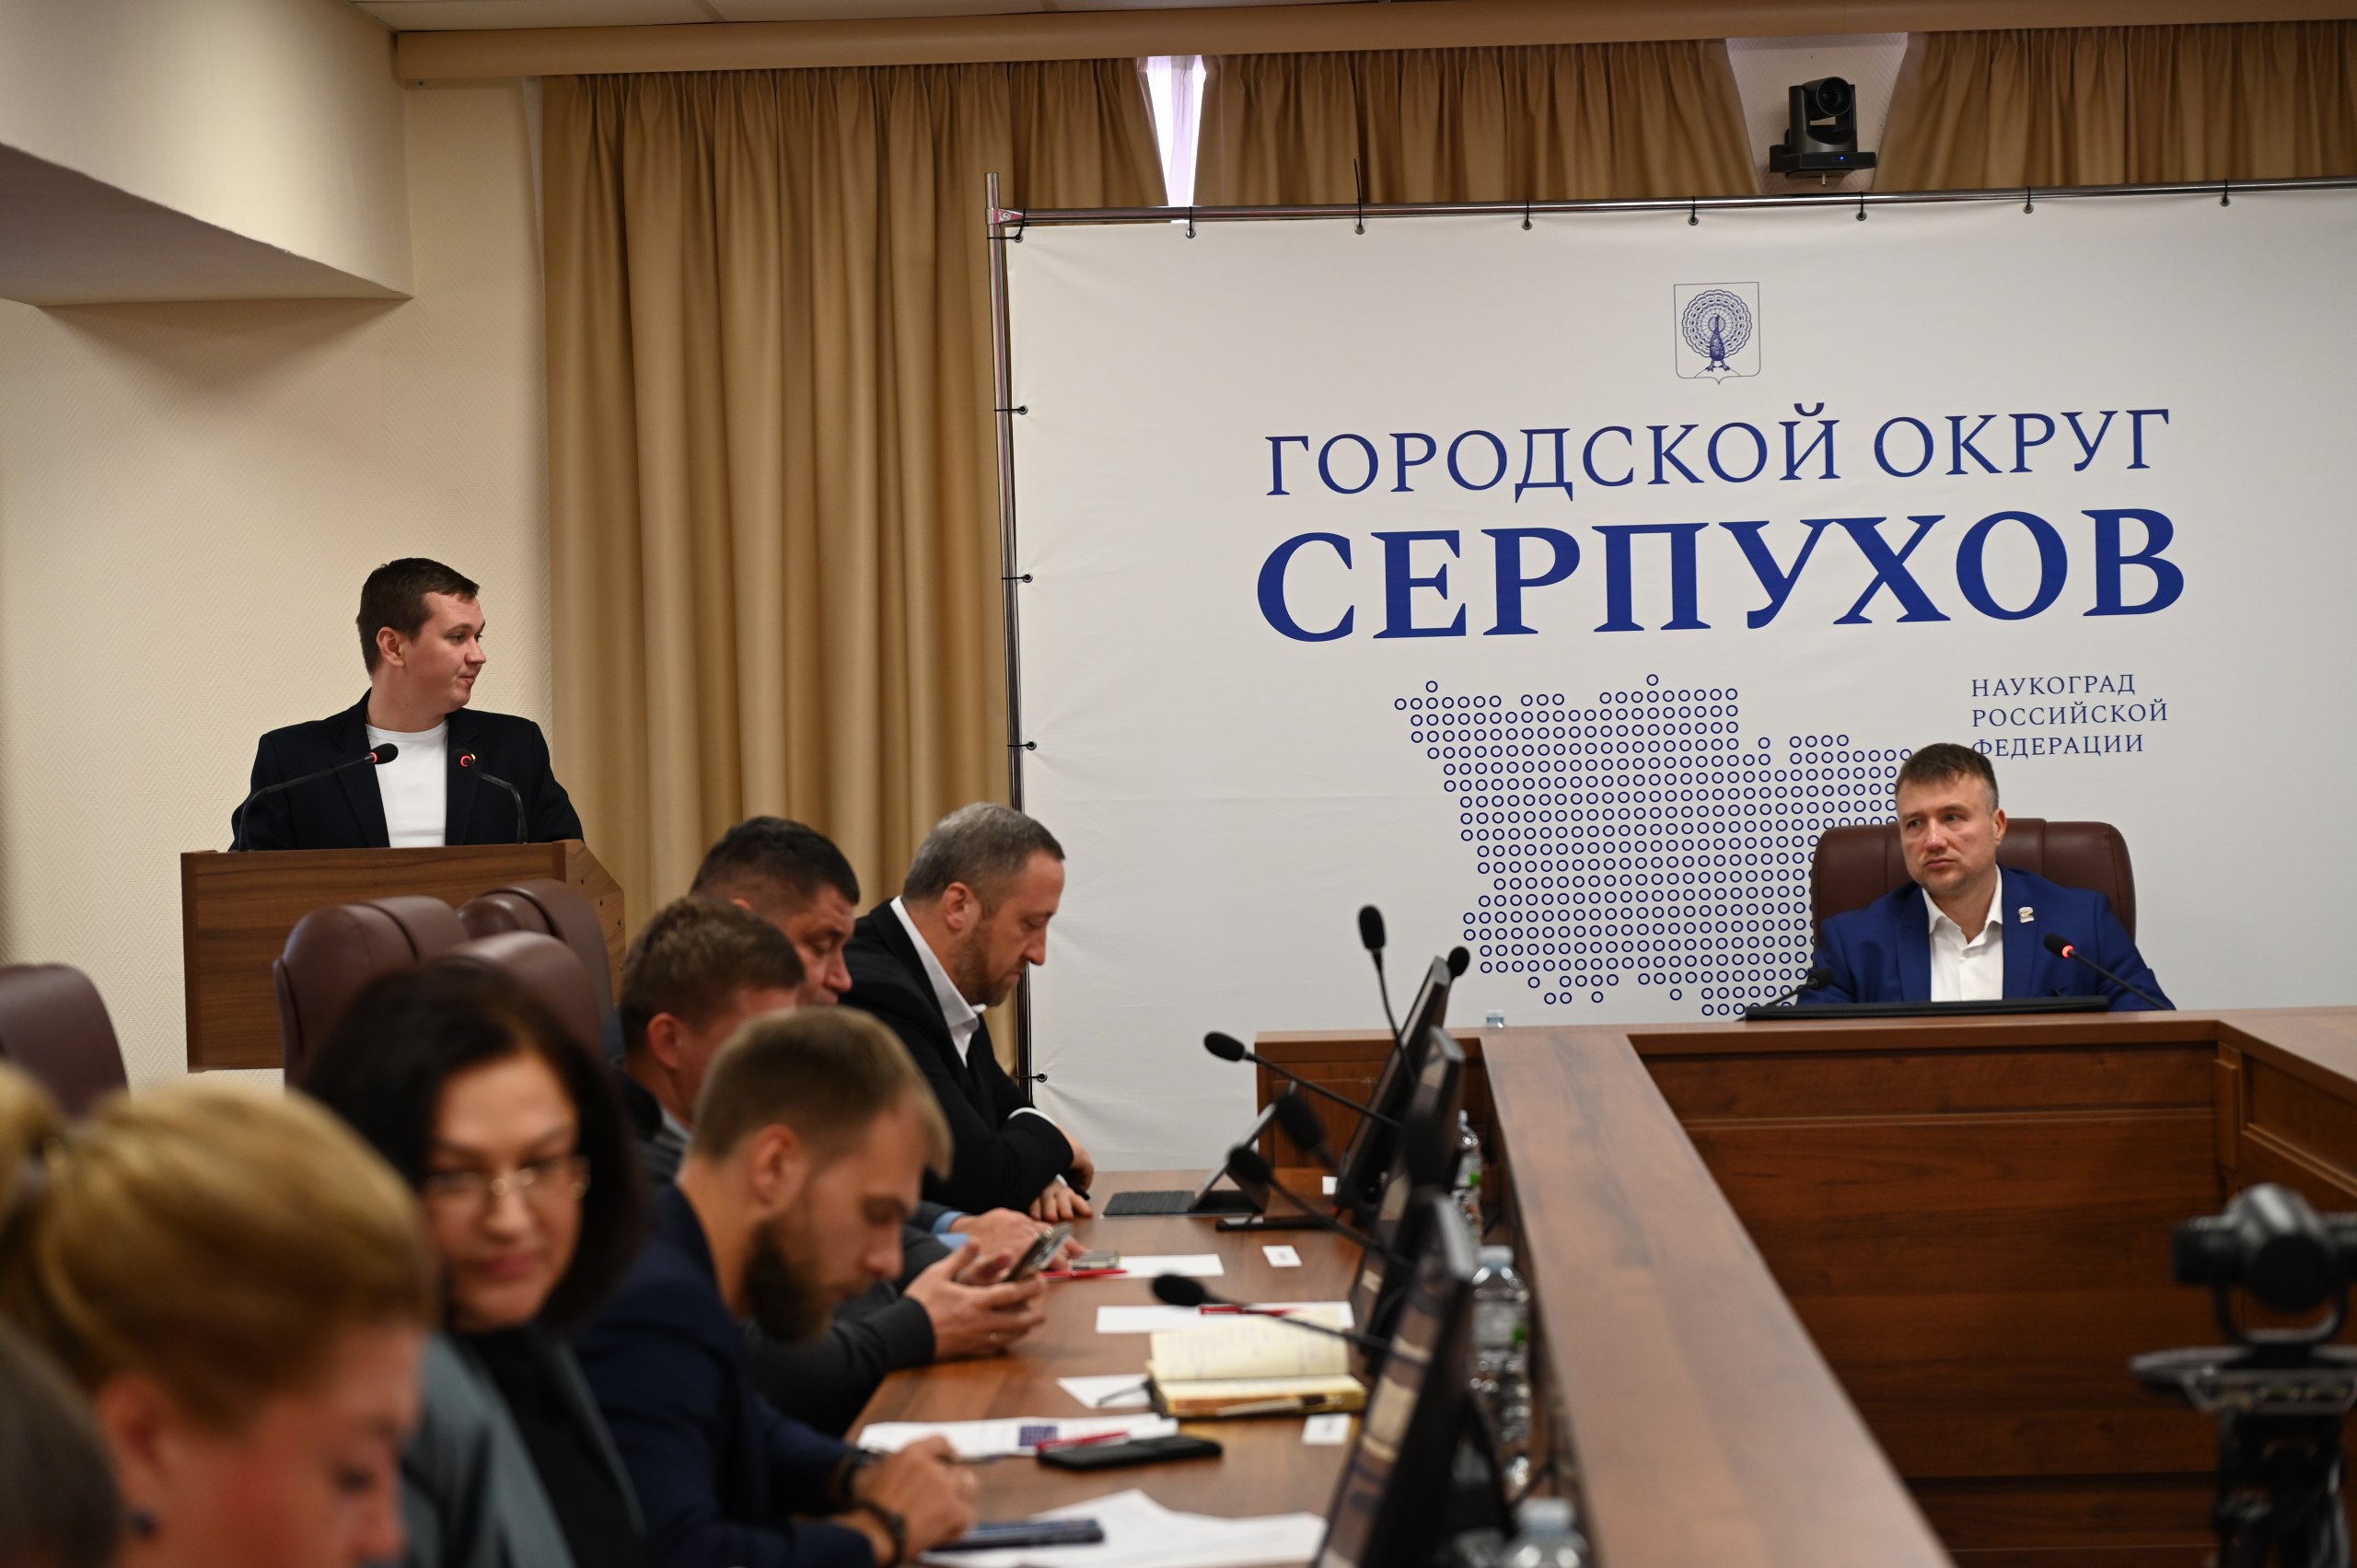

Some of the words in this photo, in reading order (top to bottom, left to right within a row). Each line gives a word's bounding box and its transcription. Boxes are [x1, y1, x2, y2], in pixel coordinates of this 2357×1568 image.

[1265, 401, 1840, 503] ГОРОДСКОЙ
[1875, 409, 2170, 478] ОКРУГ
[1257, 507, 2186, 643] СЕРПУХОВ
[1971, 674, 2136, 697] НАУКОГРАД
[1972, 698, 2168, 727] РОССИЙСКОЙ
[1972, 734, 2143, 760] ФЕДЕРАЦИИ
